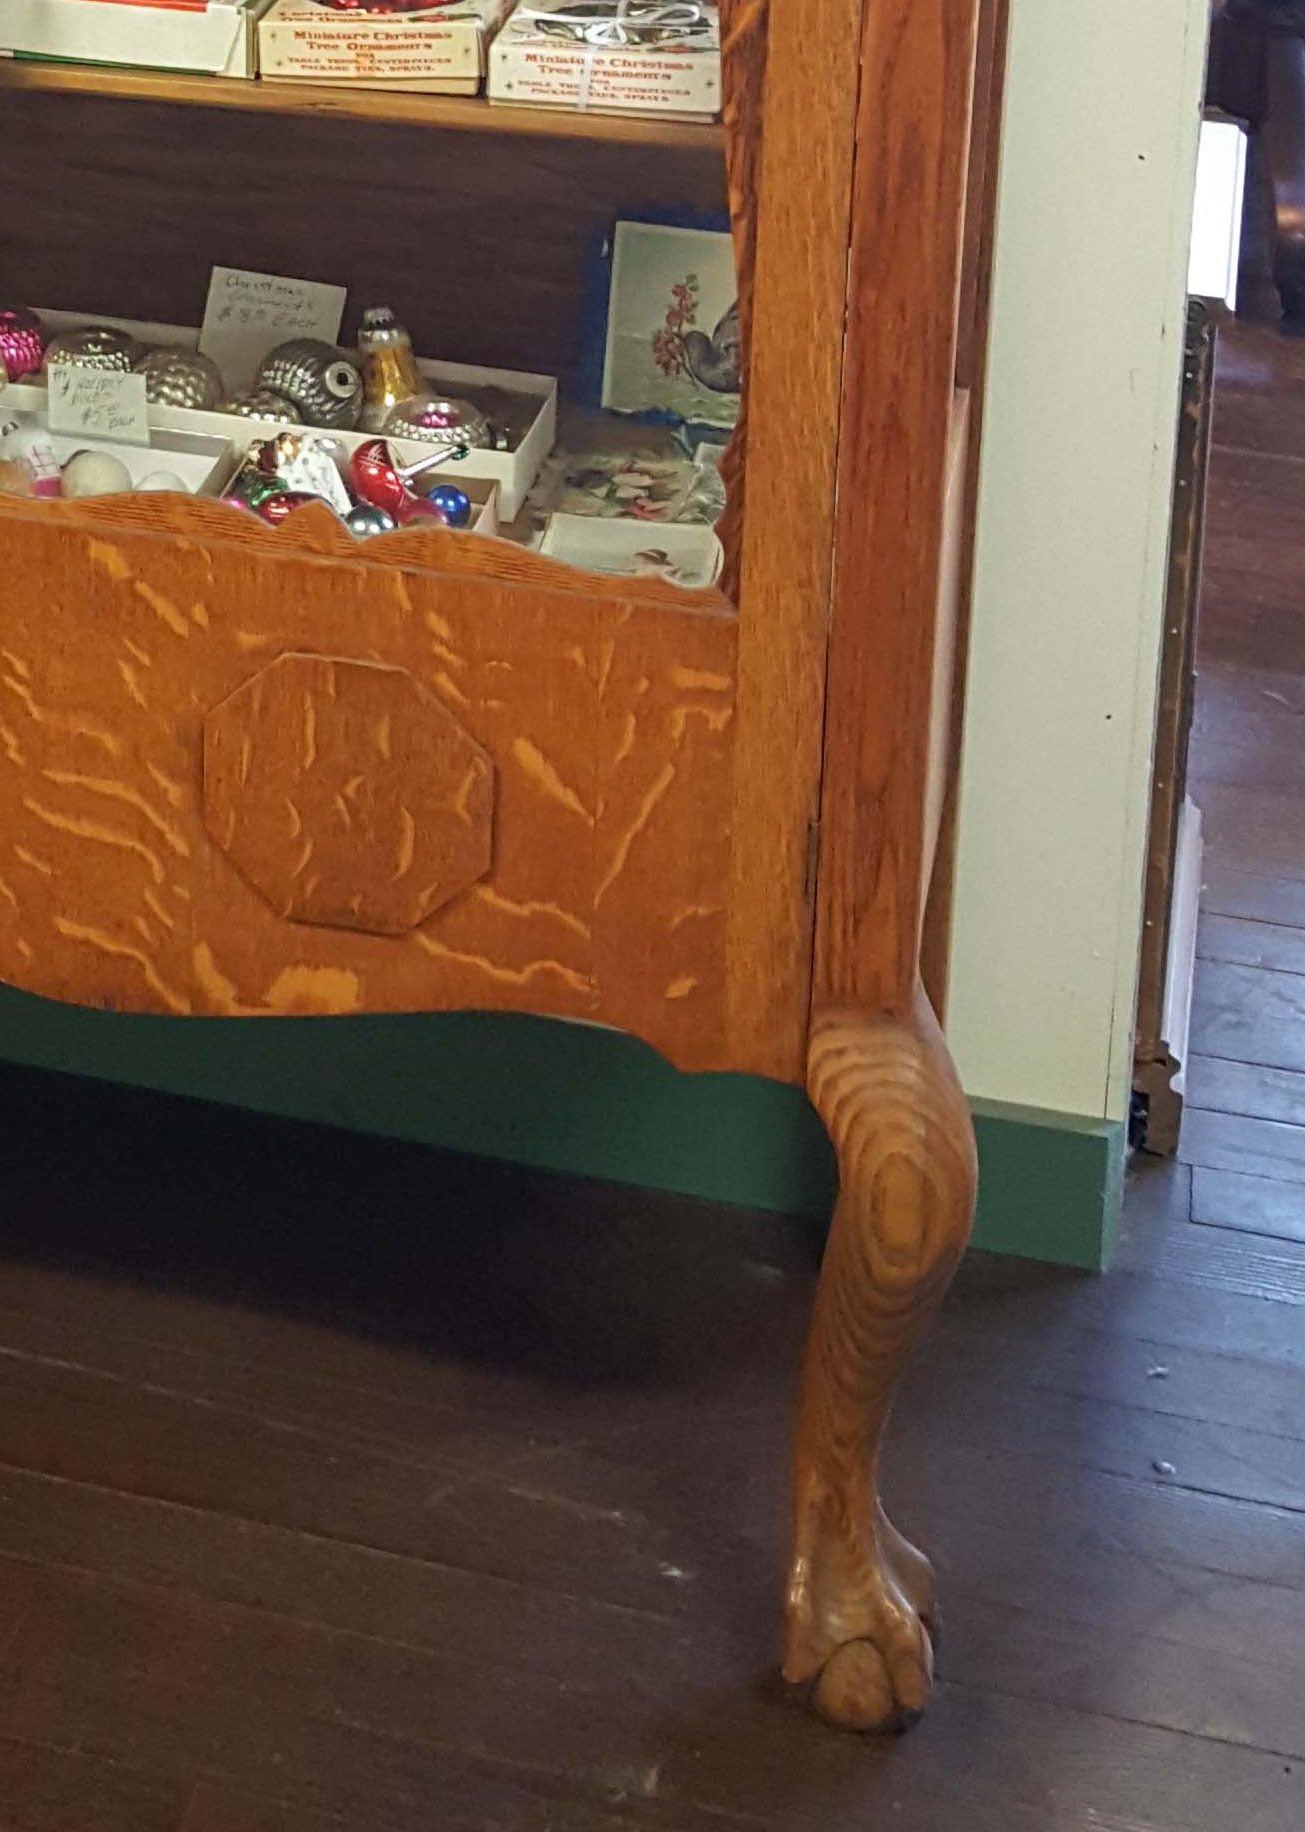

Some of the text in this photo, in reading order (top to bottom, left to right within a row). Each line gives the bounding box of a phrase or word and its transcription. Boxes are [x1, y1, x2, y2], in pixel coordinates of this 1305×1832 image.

[294, 30, 454, 42] Miniature Christmas
[306, 41, 434, 52] Tree Ornaments
[524, 53, 695, 70] Miniatue Christmas
[537, 64, 574, 76] Tree
